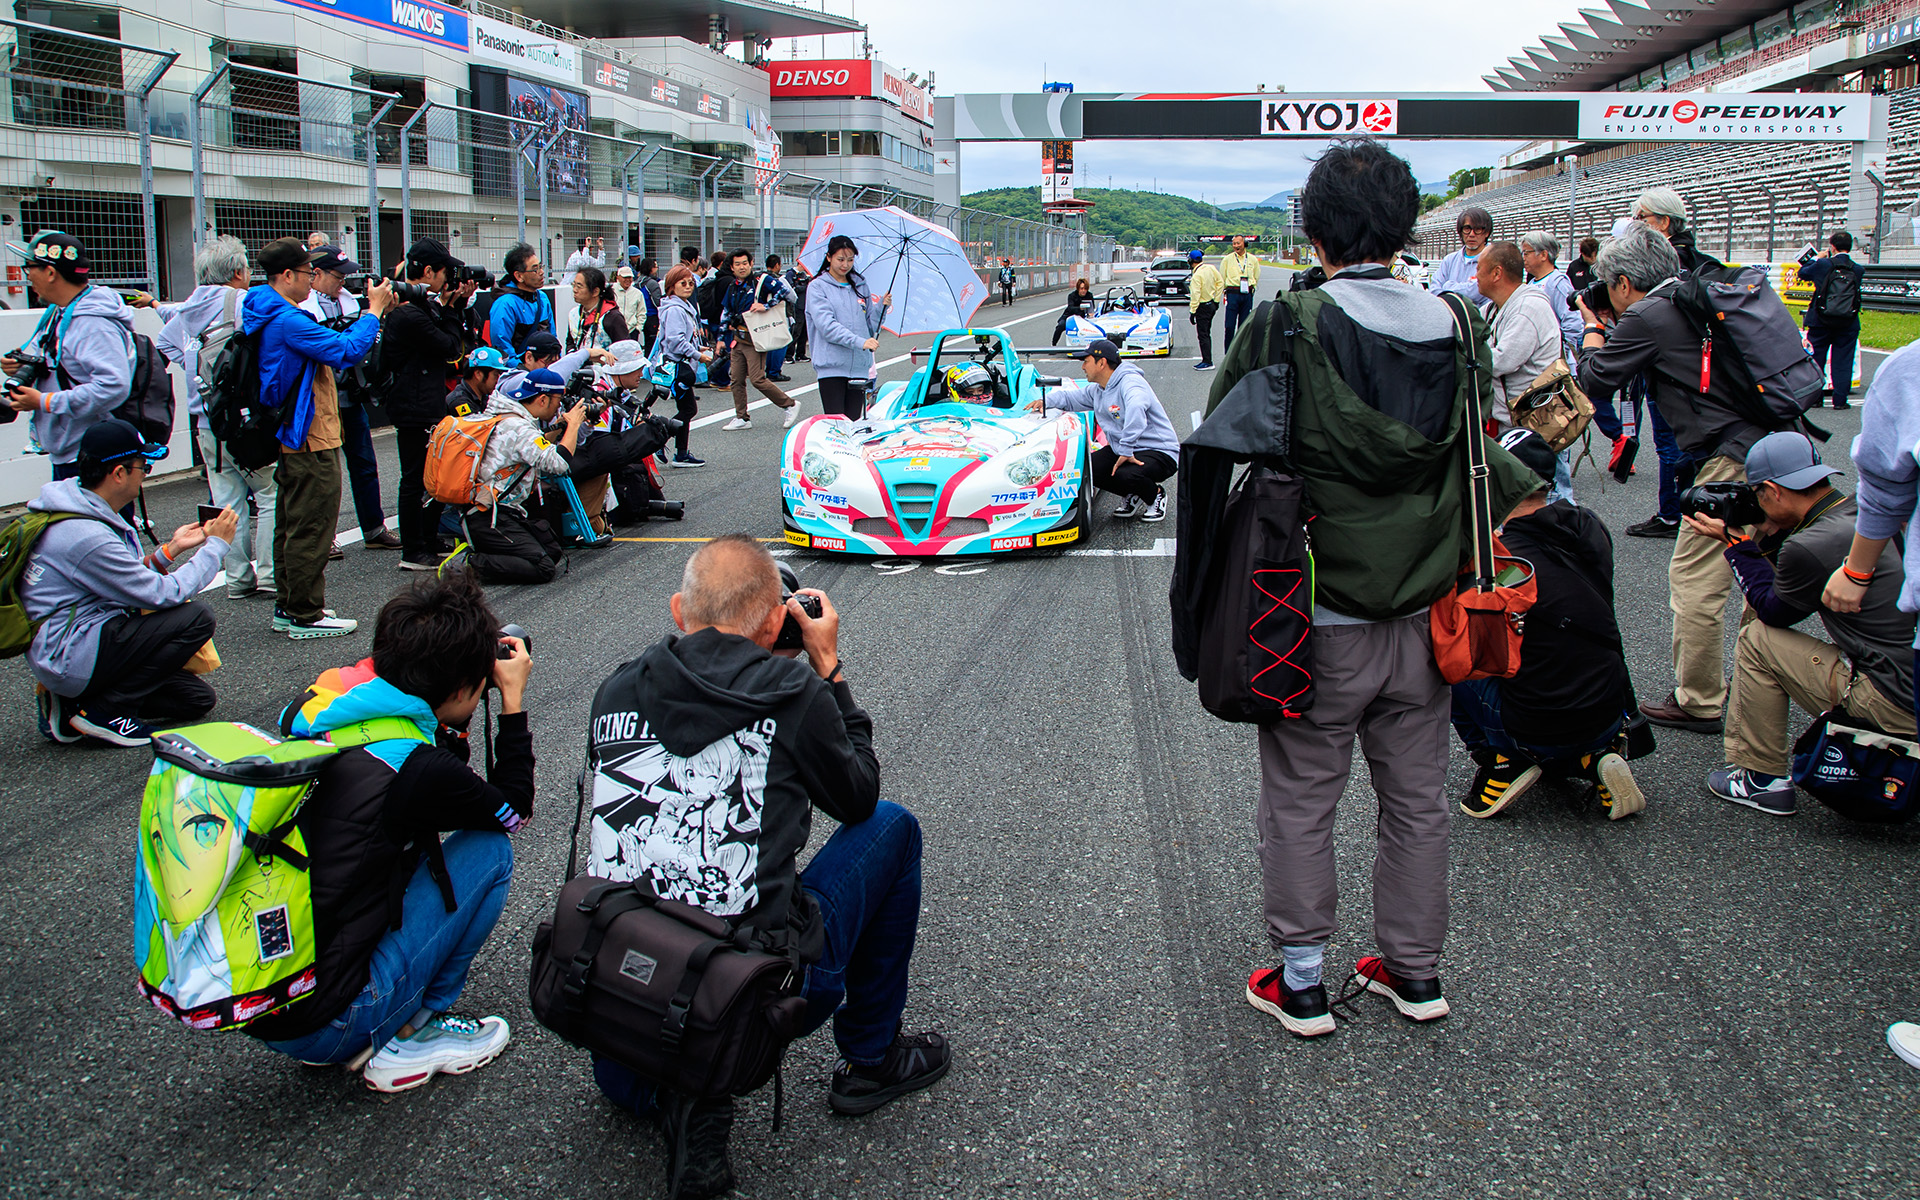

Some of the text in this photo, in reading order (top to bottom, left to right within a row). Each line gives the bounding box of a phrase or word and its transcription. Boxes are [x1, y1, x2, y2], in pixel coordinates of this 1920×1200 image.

[476, 27, 573, 72] Panasonic AUTOMOTIVE
[776, 69, 849, 86] DENSO
[1604, 125, 1843, 133] ENJOY! MOTORSPORTS
[461, 405, 466, 413] 4
[784, 486, 805, 500] AIM
[1047, 486, 1076, 500] AIM
[1048, 531, 1077, 542] DUNLOP
[813, 537, 845, 549] MOTUL
[992, 537, 1031, 549] MOTUL
